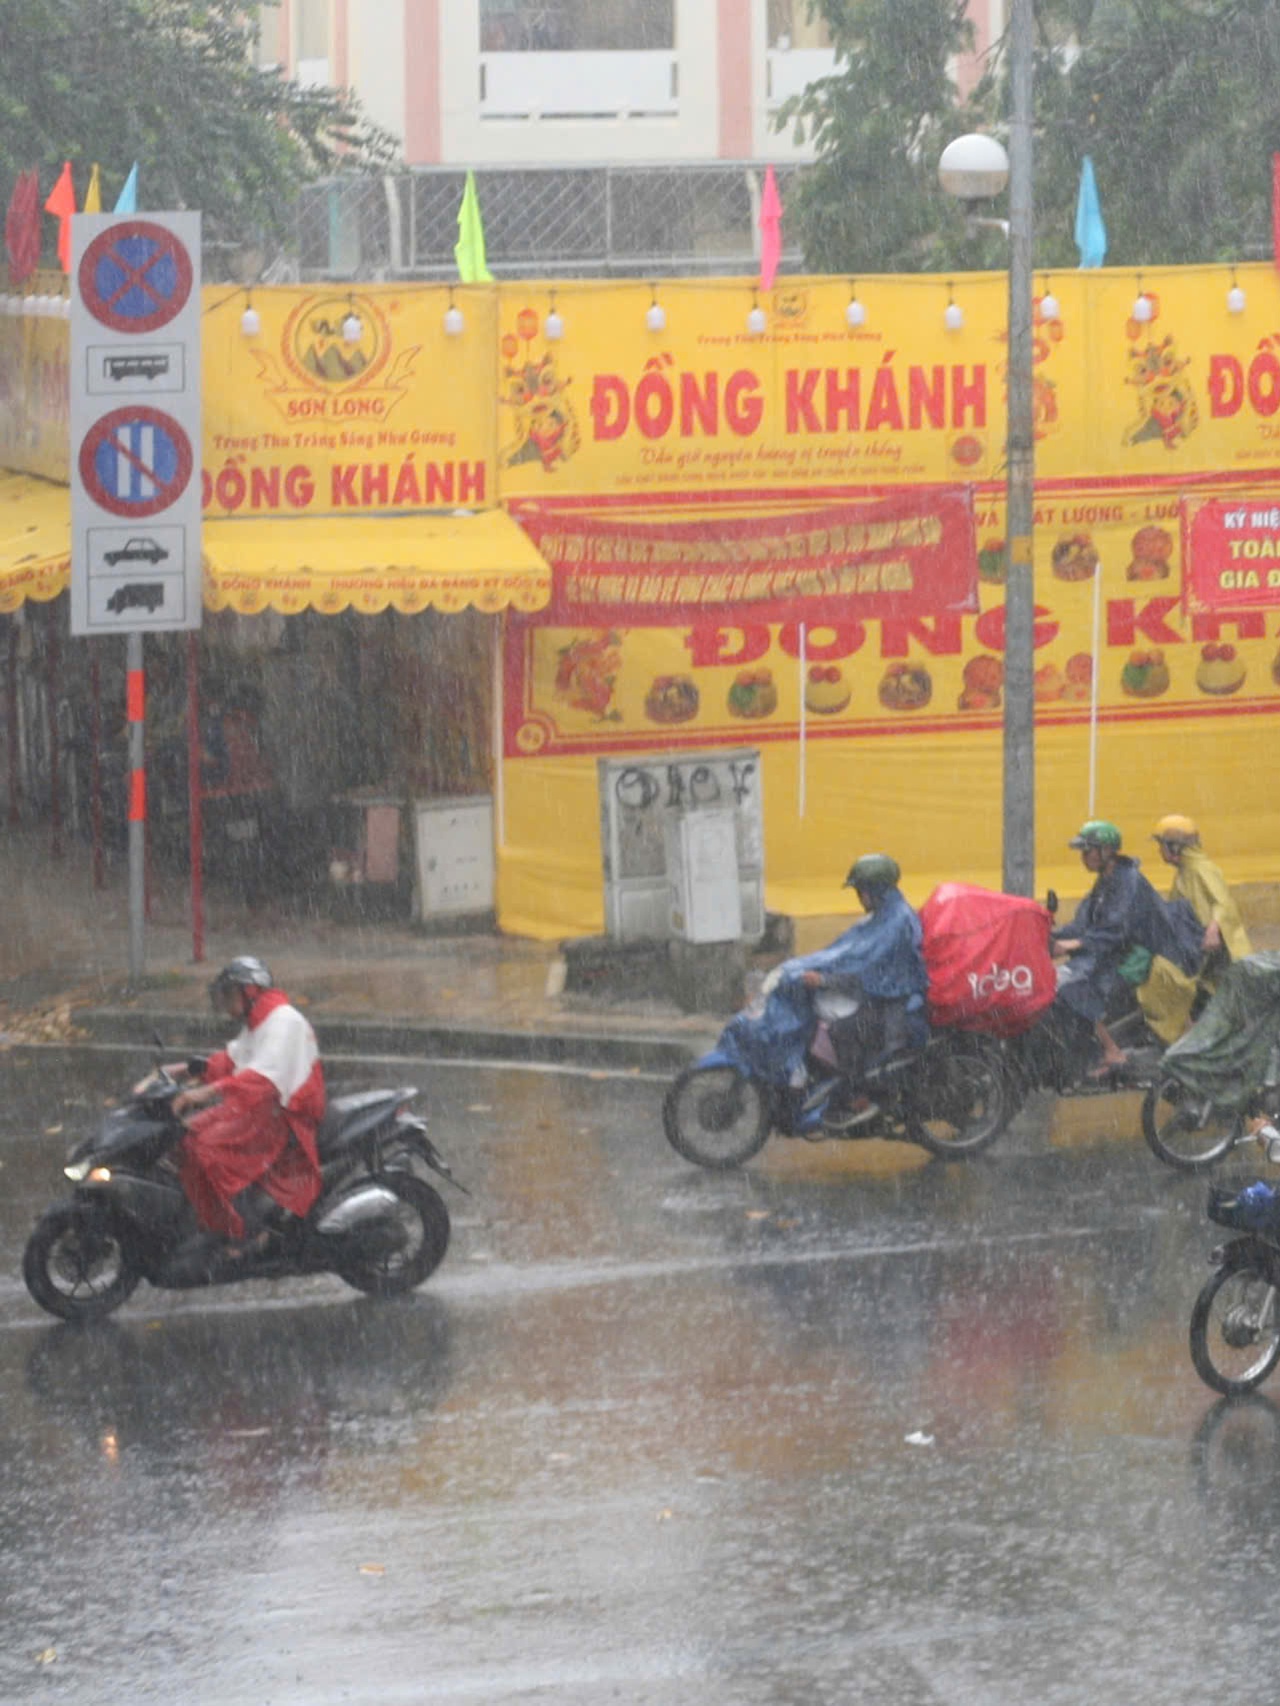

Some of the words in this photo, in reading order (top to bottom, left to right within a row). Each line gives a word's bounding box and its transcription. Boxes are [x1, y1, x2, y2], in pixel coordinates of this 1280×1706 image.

[332, 397, 385, 416] LONG
[589, 352, 765, 441] ĐỒNG
[784, 350, 988, 434] KHÁNH
[330, 452, 487, 507] KHÁNH
[1219, 569, 1260, 590] GIA
